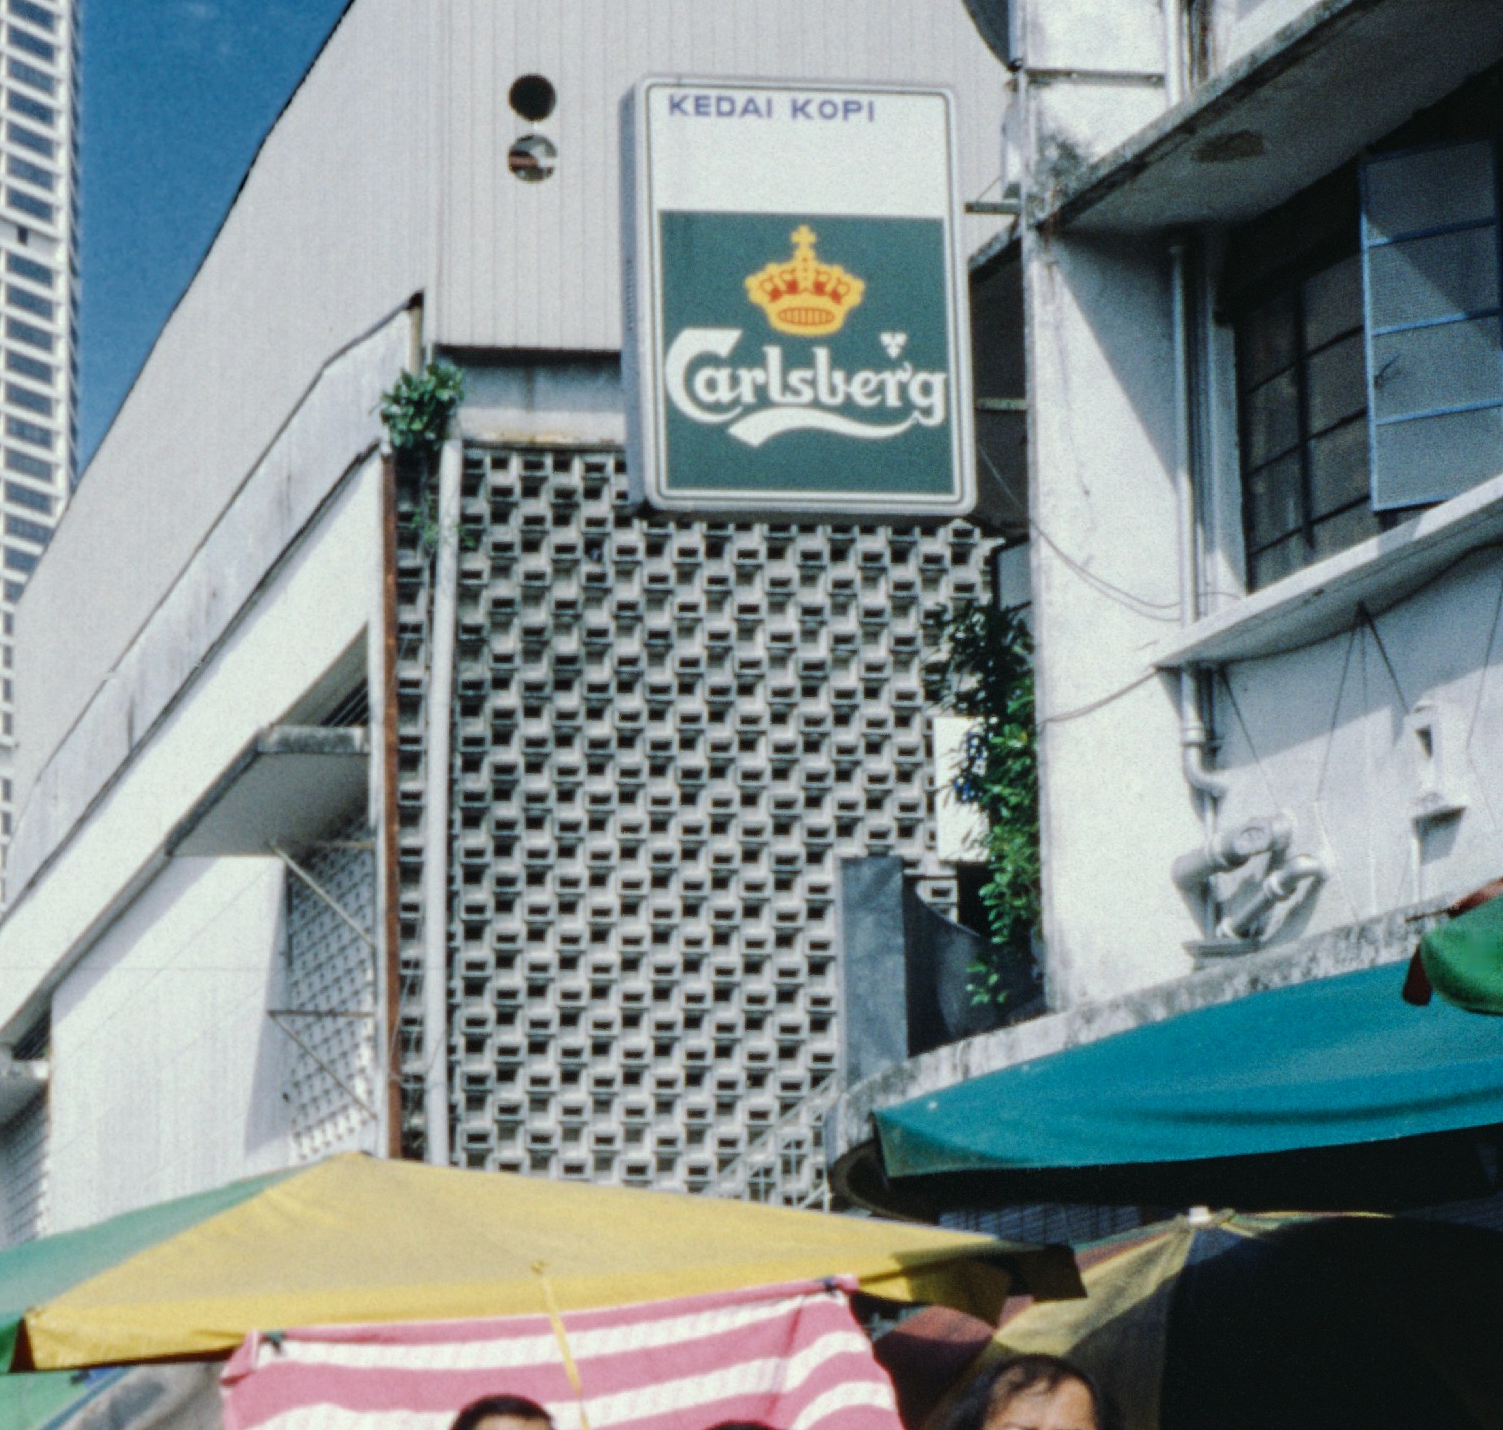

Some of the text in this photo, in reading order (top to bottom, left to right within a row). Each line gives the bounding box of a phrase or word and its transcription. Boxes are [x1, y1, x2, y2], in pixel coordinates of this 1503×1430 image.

[668, 94, 875, 122] KEDAI KOPI
[664, 327, 948, 431] Carlsberg
